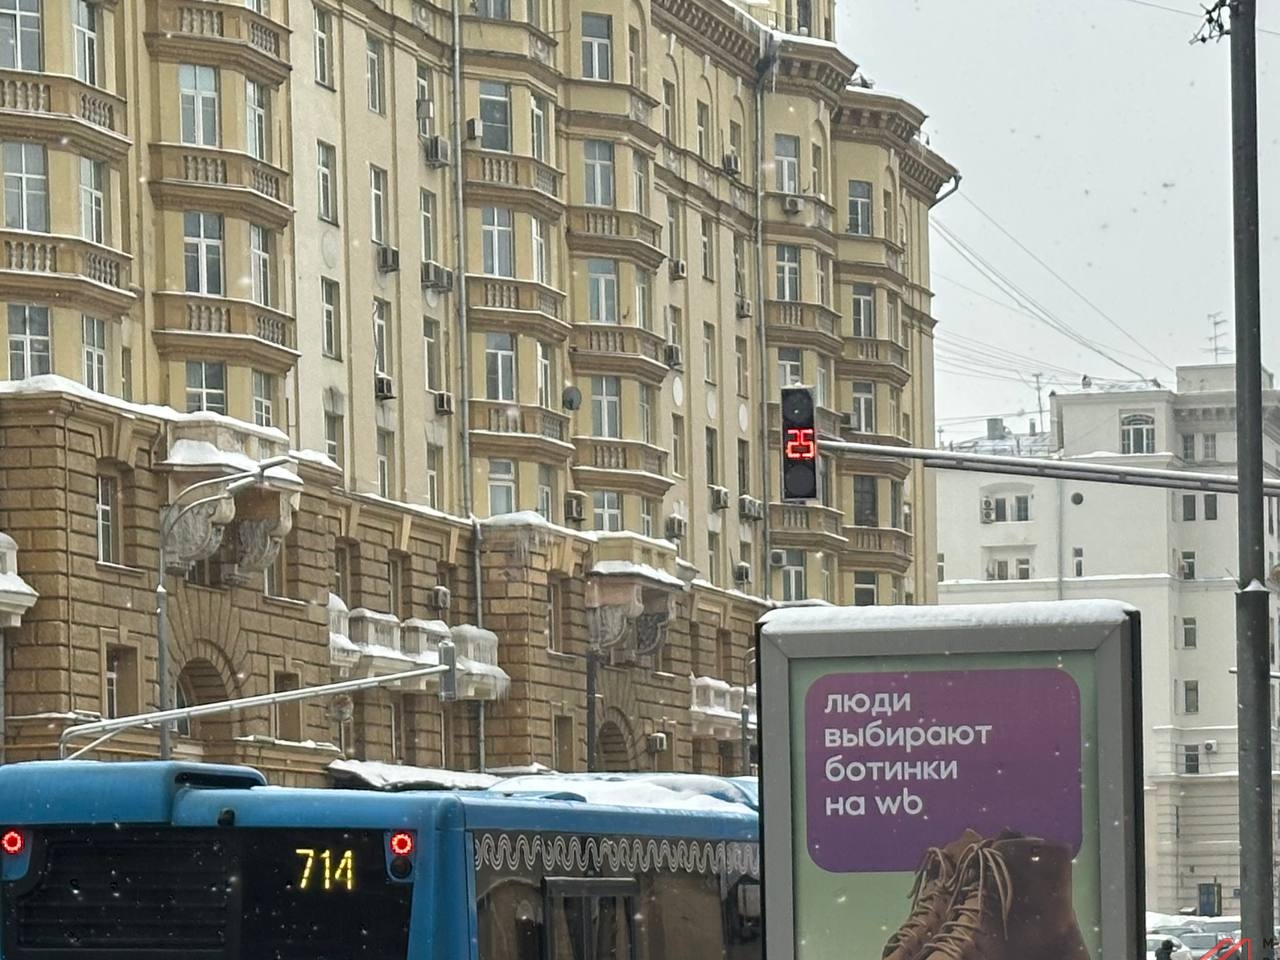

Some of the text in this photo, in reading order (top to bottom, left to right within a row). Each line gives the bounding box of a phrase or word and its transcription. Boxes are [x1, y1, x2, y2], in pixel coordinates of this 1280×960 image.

[786, 429, 814, 458] 25
[824, 693, 911, 716] люди
[824, 719, 993, 753] выбирают
[825, 754, 958, 782] ботинки
[825, 787, 923, 816] на wb
[296, 849, 352, 889] 714
